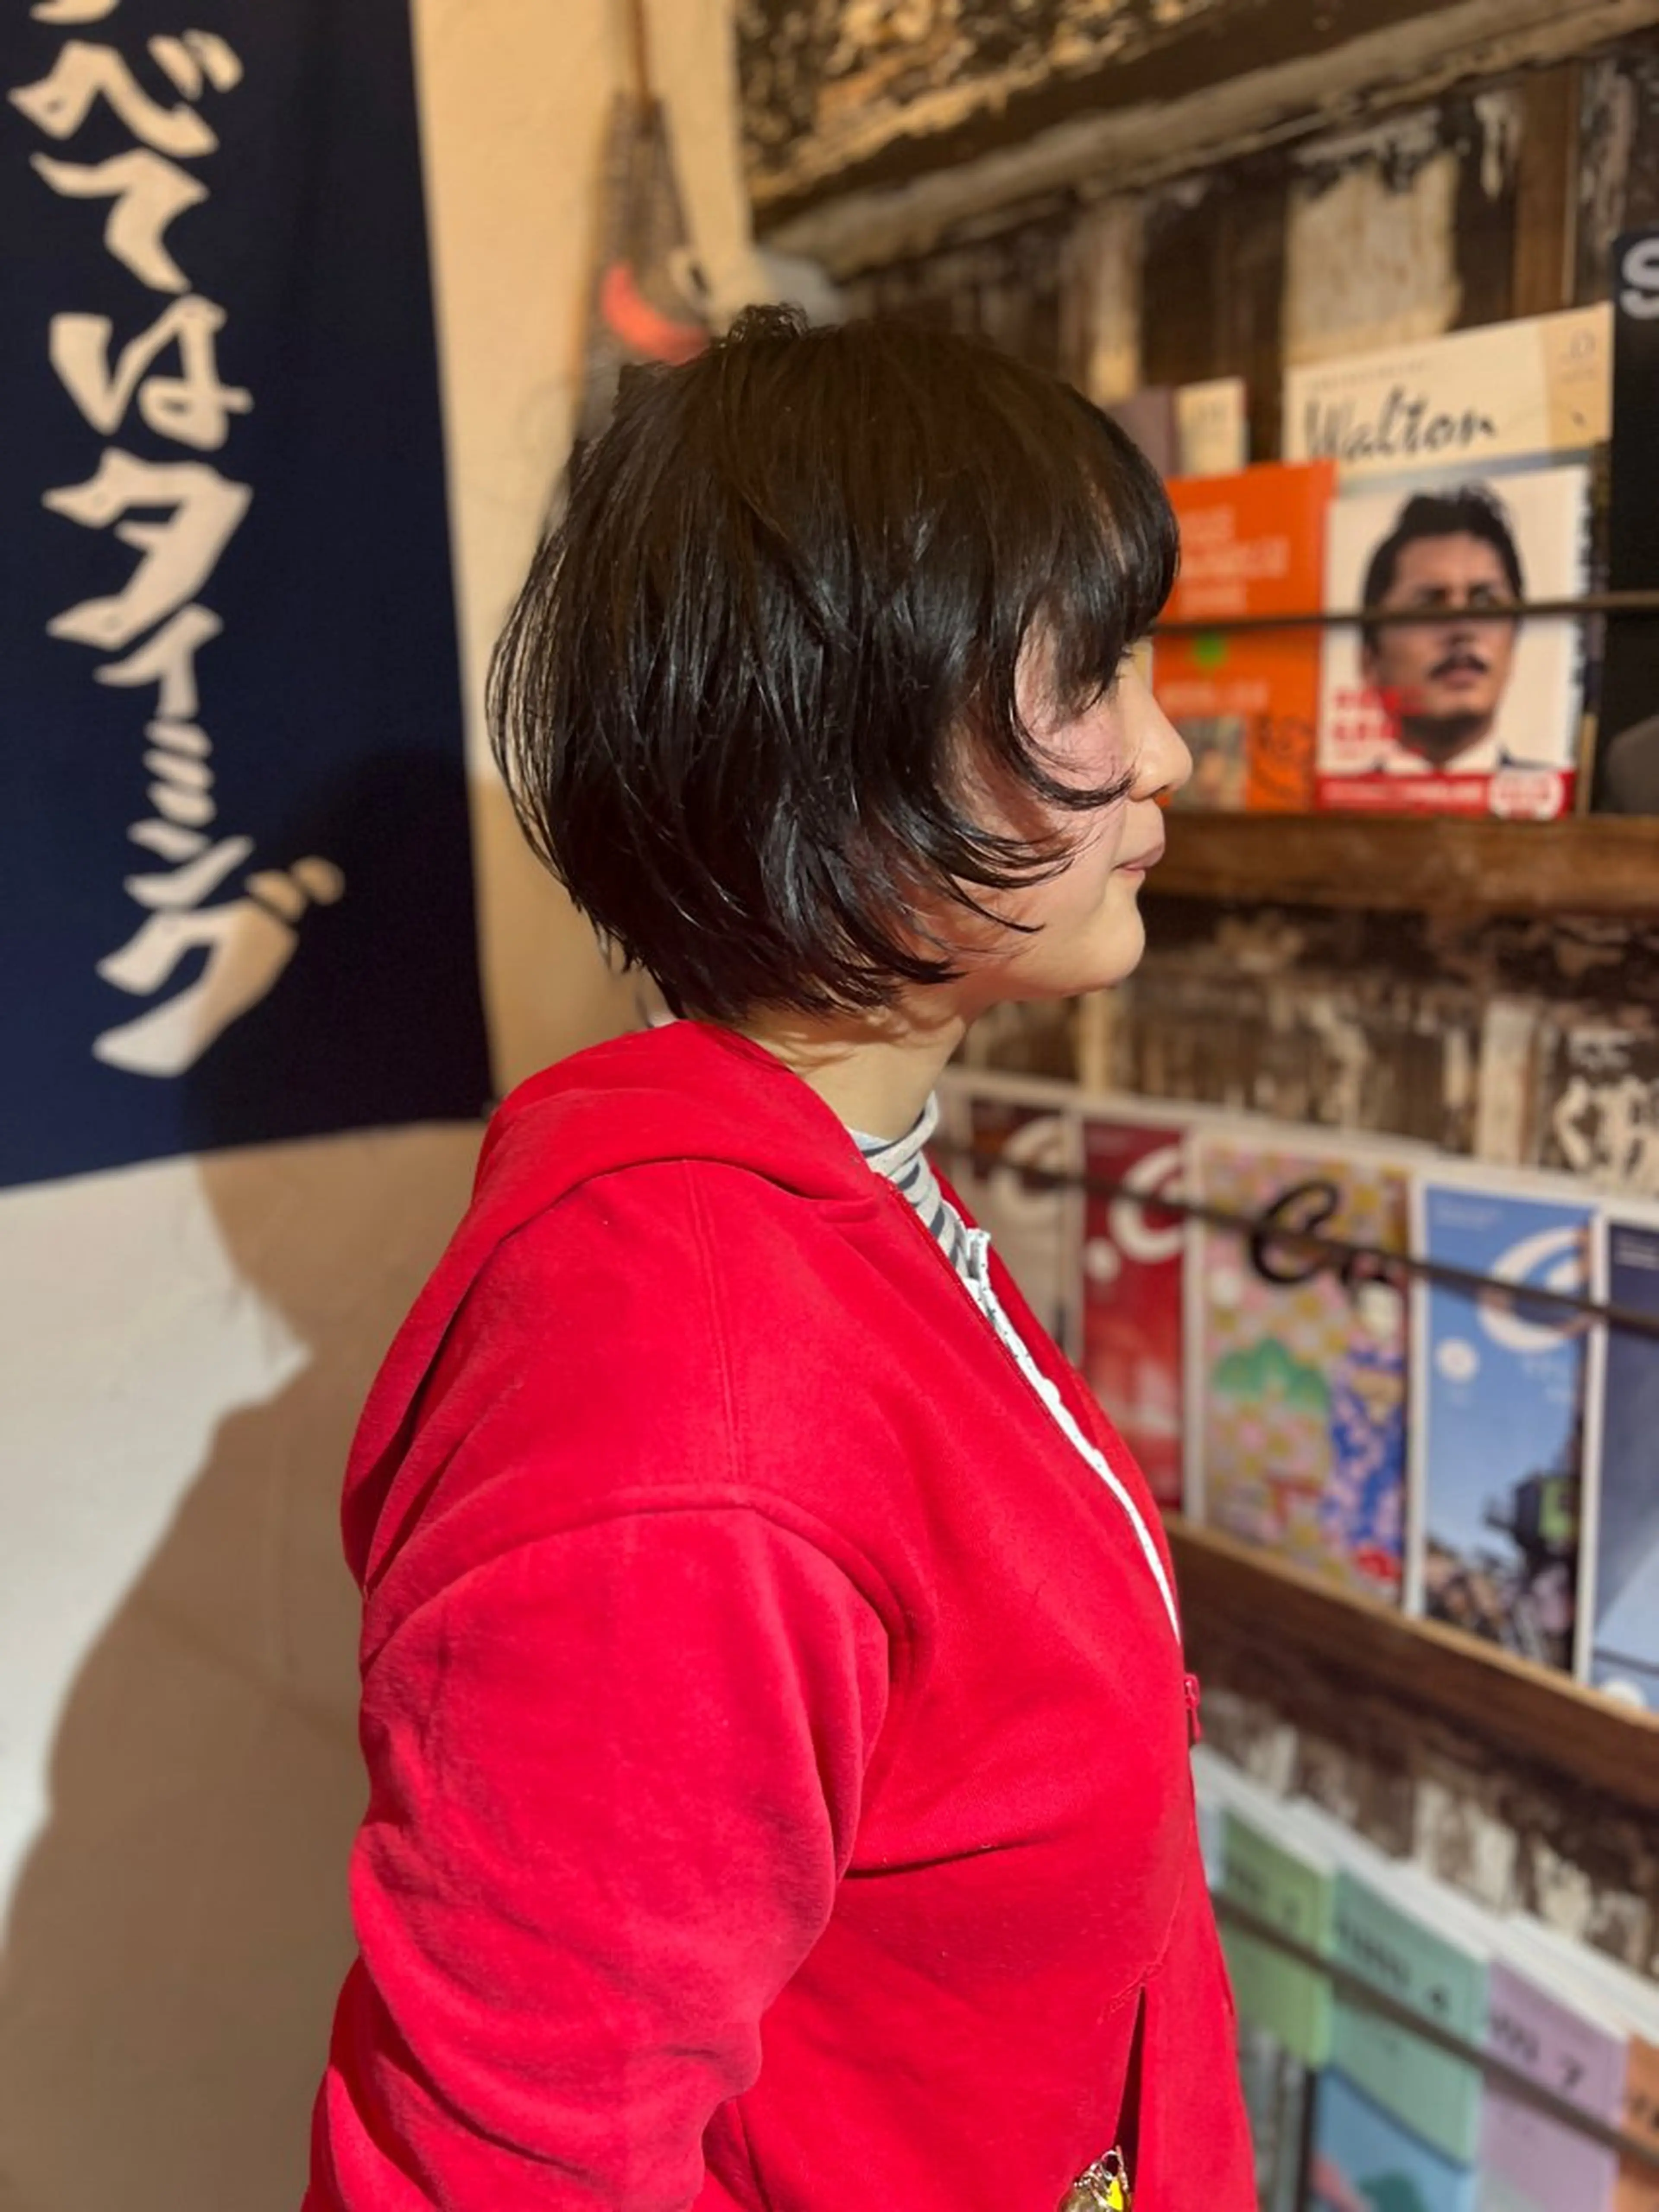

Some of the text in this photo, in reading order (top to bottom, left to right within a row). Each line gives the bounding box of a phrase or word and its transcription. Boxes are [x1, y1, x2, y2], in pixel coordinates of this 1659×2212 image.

[6, 0, 345, 1077] べてはタイミング
[1304, 384, 1497, 463] Walton
